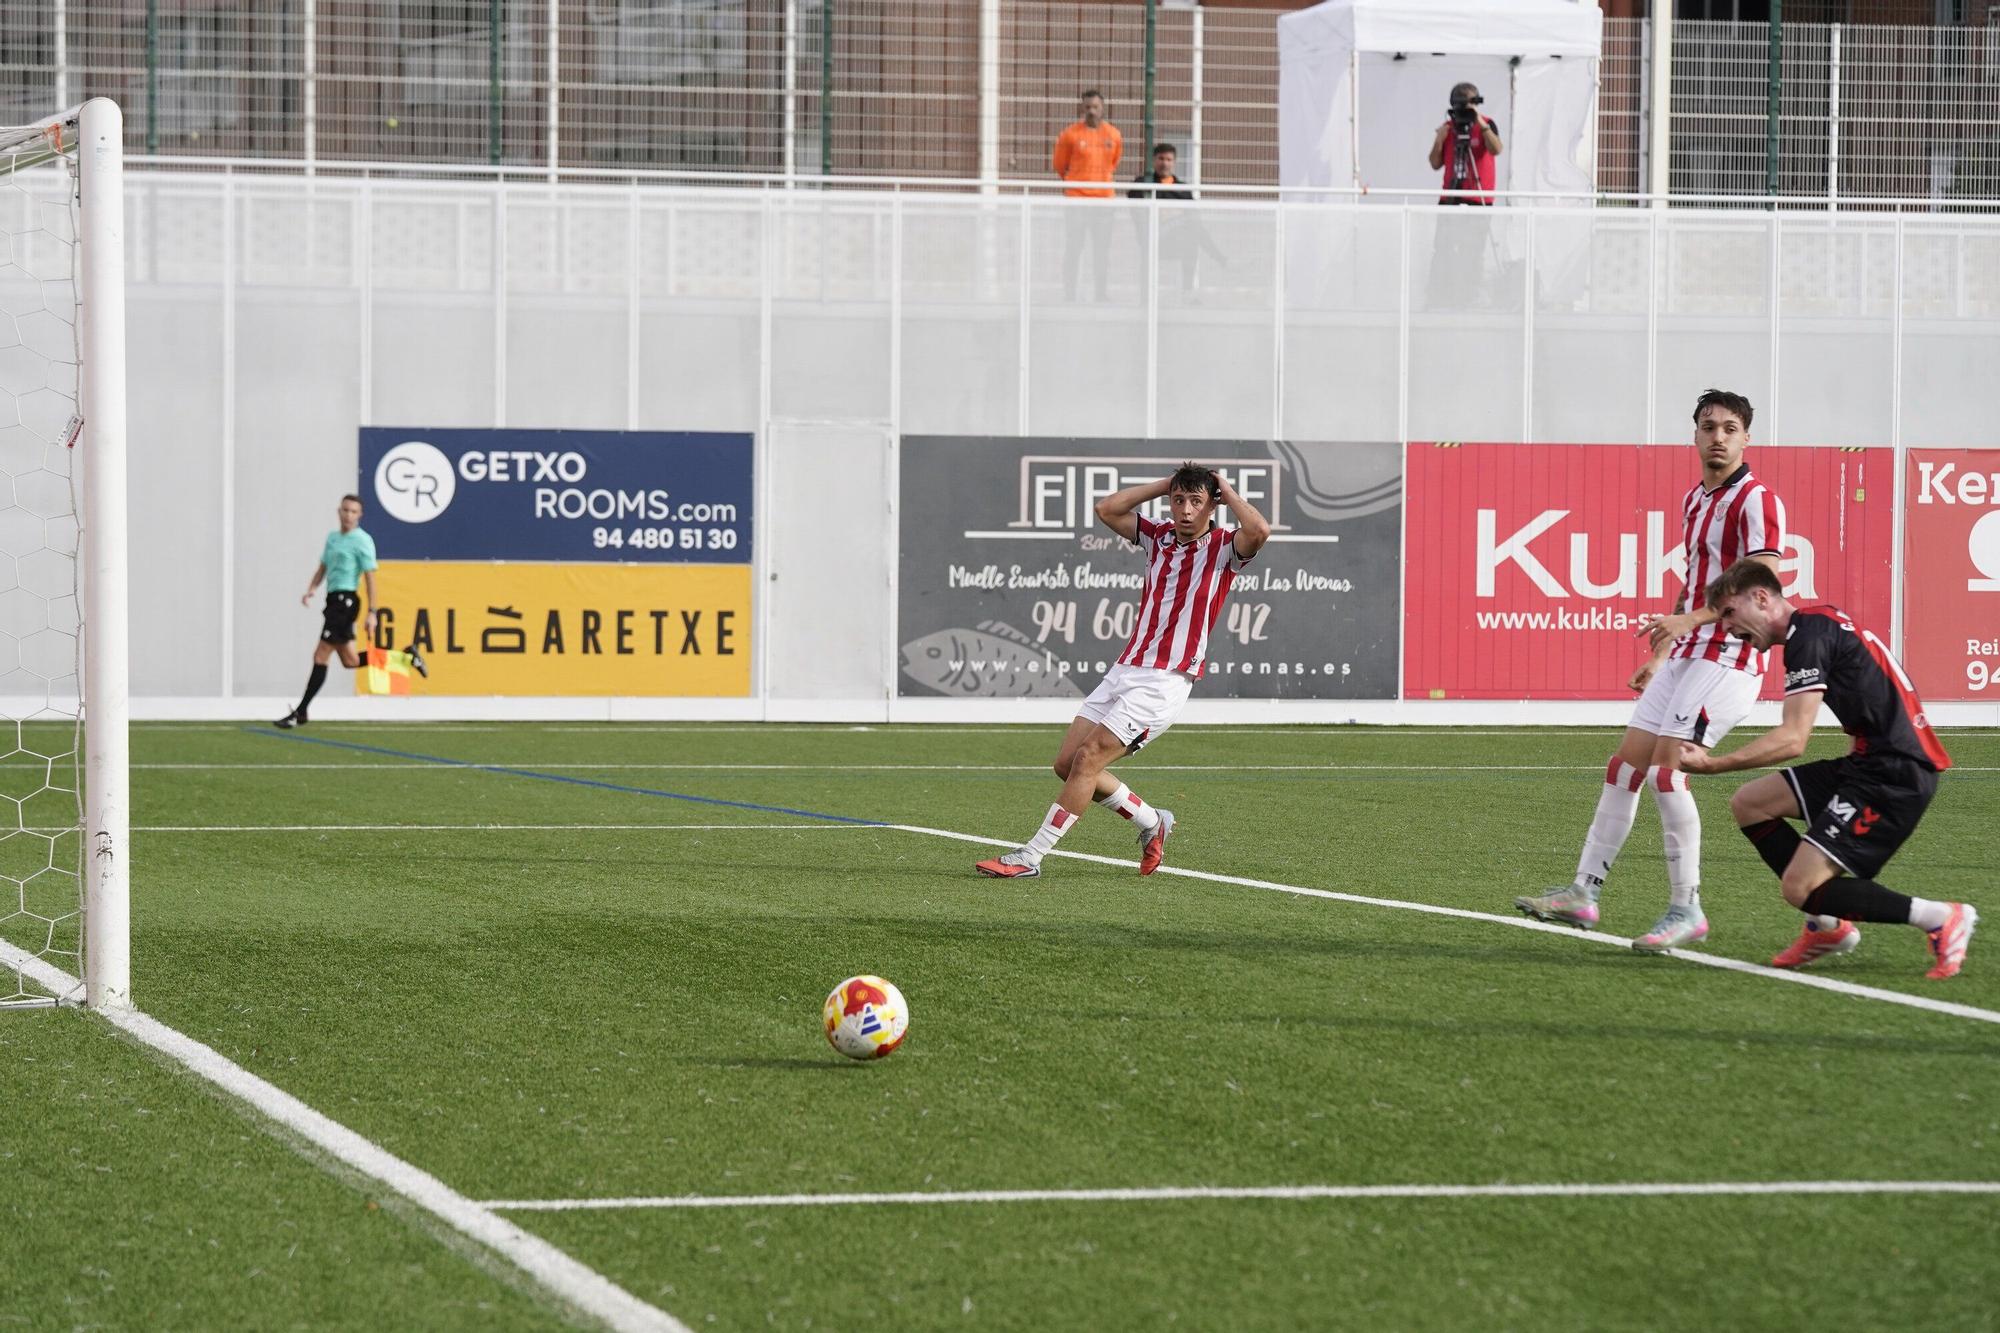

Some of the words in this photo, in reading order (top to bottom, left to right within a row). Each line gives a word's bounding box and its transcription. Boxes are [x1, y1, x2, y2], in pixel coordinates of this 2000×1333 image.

[458, 451, 587, 482] GETXO
[535, 488, 737, 523] ROOMS.com
[592, 527, 624, 549] 94
[628, 527, 675, 549] 480
[679, 528, 703, 549] 51
[707, 528, 738, 549] 30
[1080, 534, 1113, 551] Bar
[1476, 509, 1819, 599] Kuka
[949, 564, 1005, 589] Muelle
[1008, 563, 1070, 590] Evaristo
[1263, 567, 1292, 592] Las
[1032, 600, 1077, 644] 94
[1093, 598, 1142, 641] 60
[1227, 602, 1272, 645] 42
[1476, 606, 1665, 632] www.kukla-s
